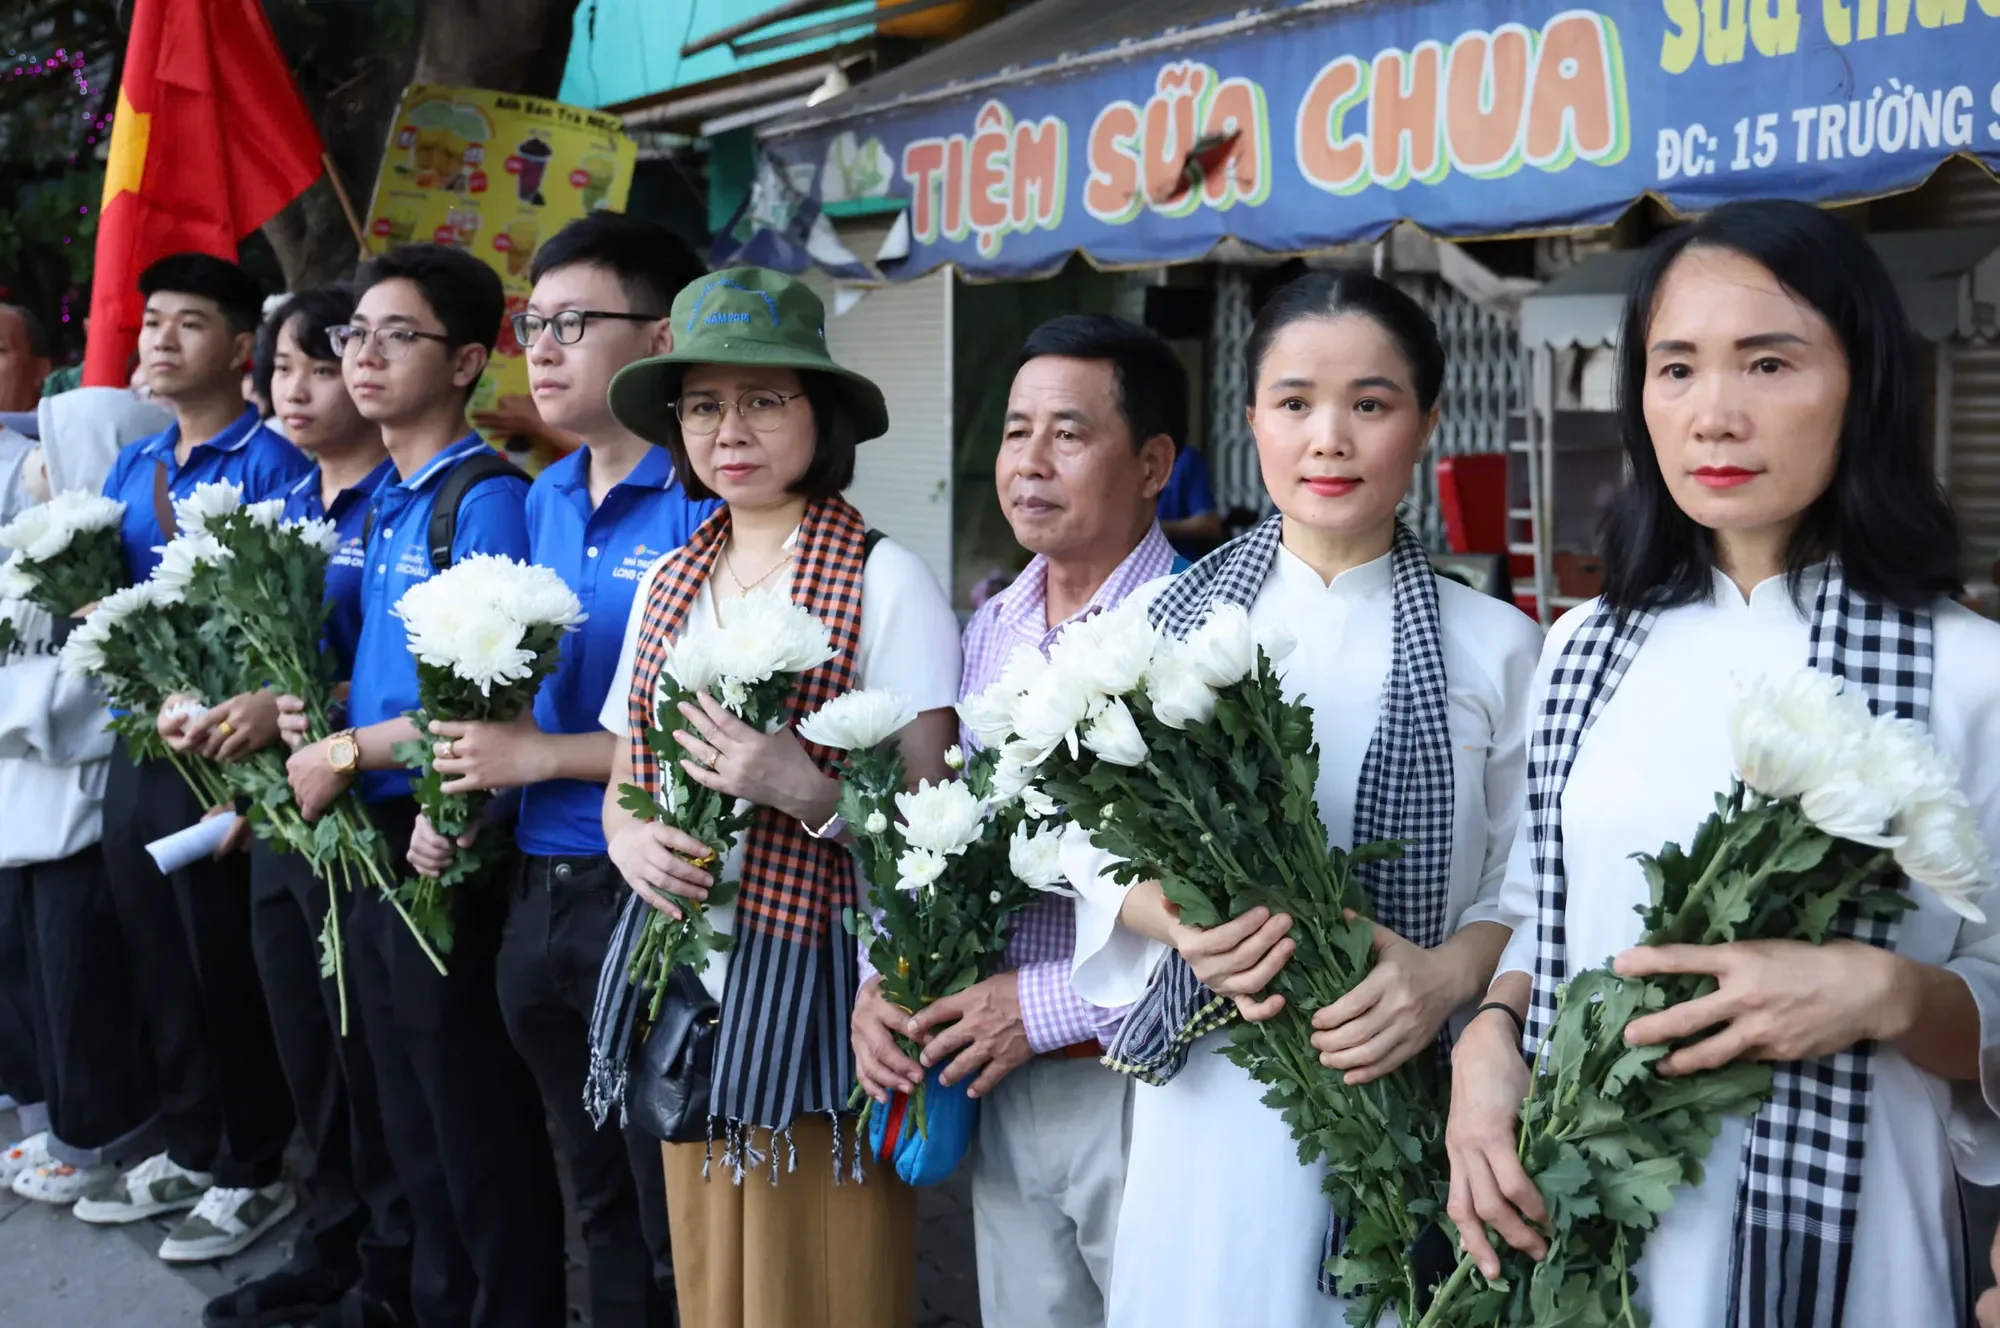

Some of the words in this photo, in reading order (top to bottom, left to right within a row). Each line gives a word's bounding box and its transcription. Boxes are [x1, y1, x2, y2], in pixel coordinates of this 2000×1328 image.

[904, 100, 1066, 257] TIỆM
[1084, 60, 1270, 222] SỮA
[1296, 10, 1630, 195] CHUA
[1656, 123, 1718, 181] ĐC:
[1730, 113, 1779, 171] 15
[1791, 77, 1974, 163] TRƯỜNG
[612, 567, 637, 580] LONG
